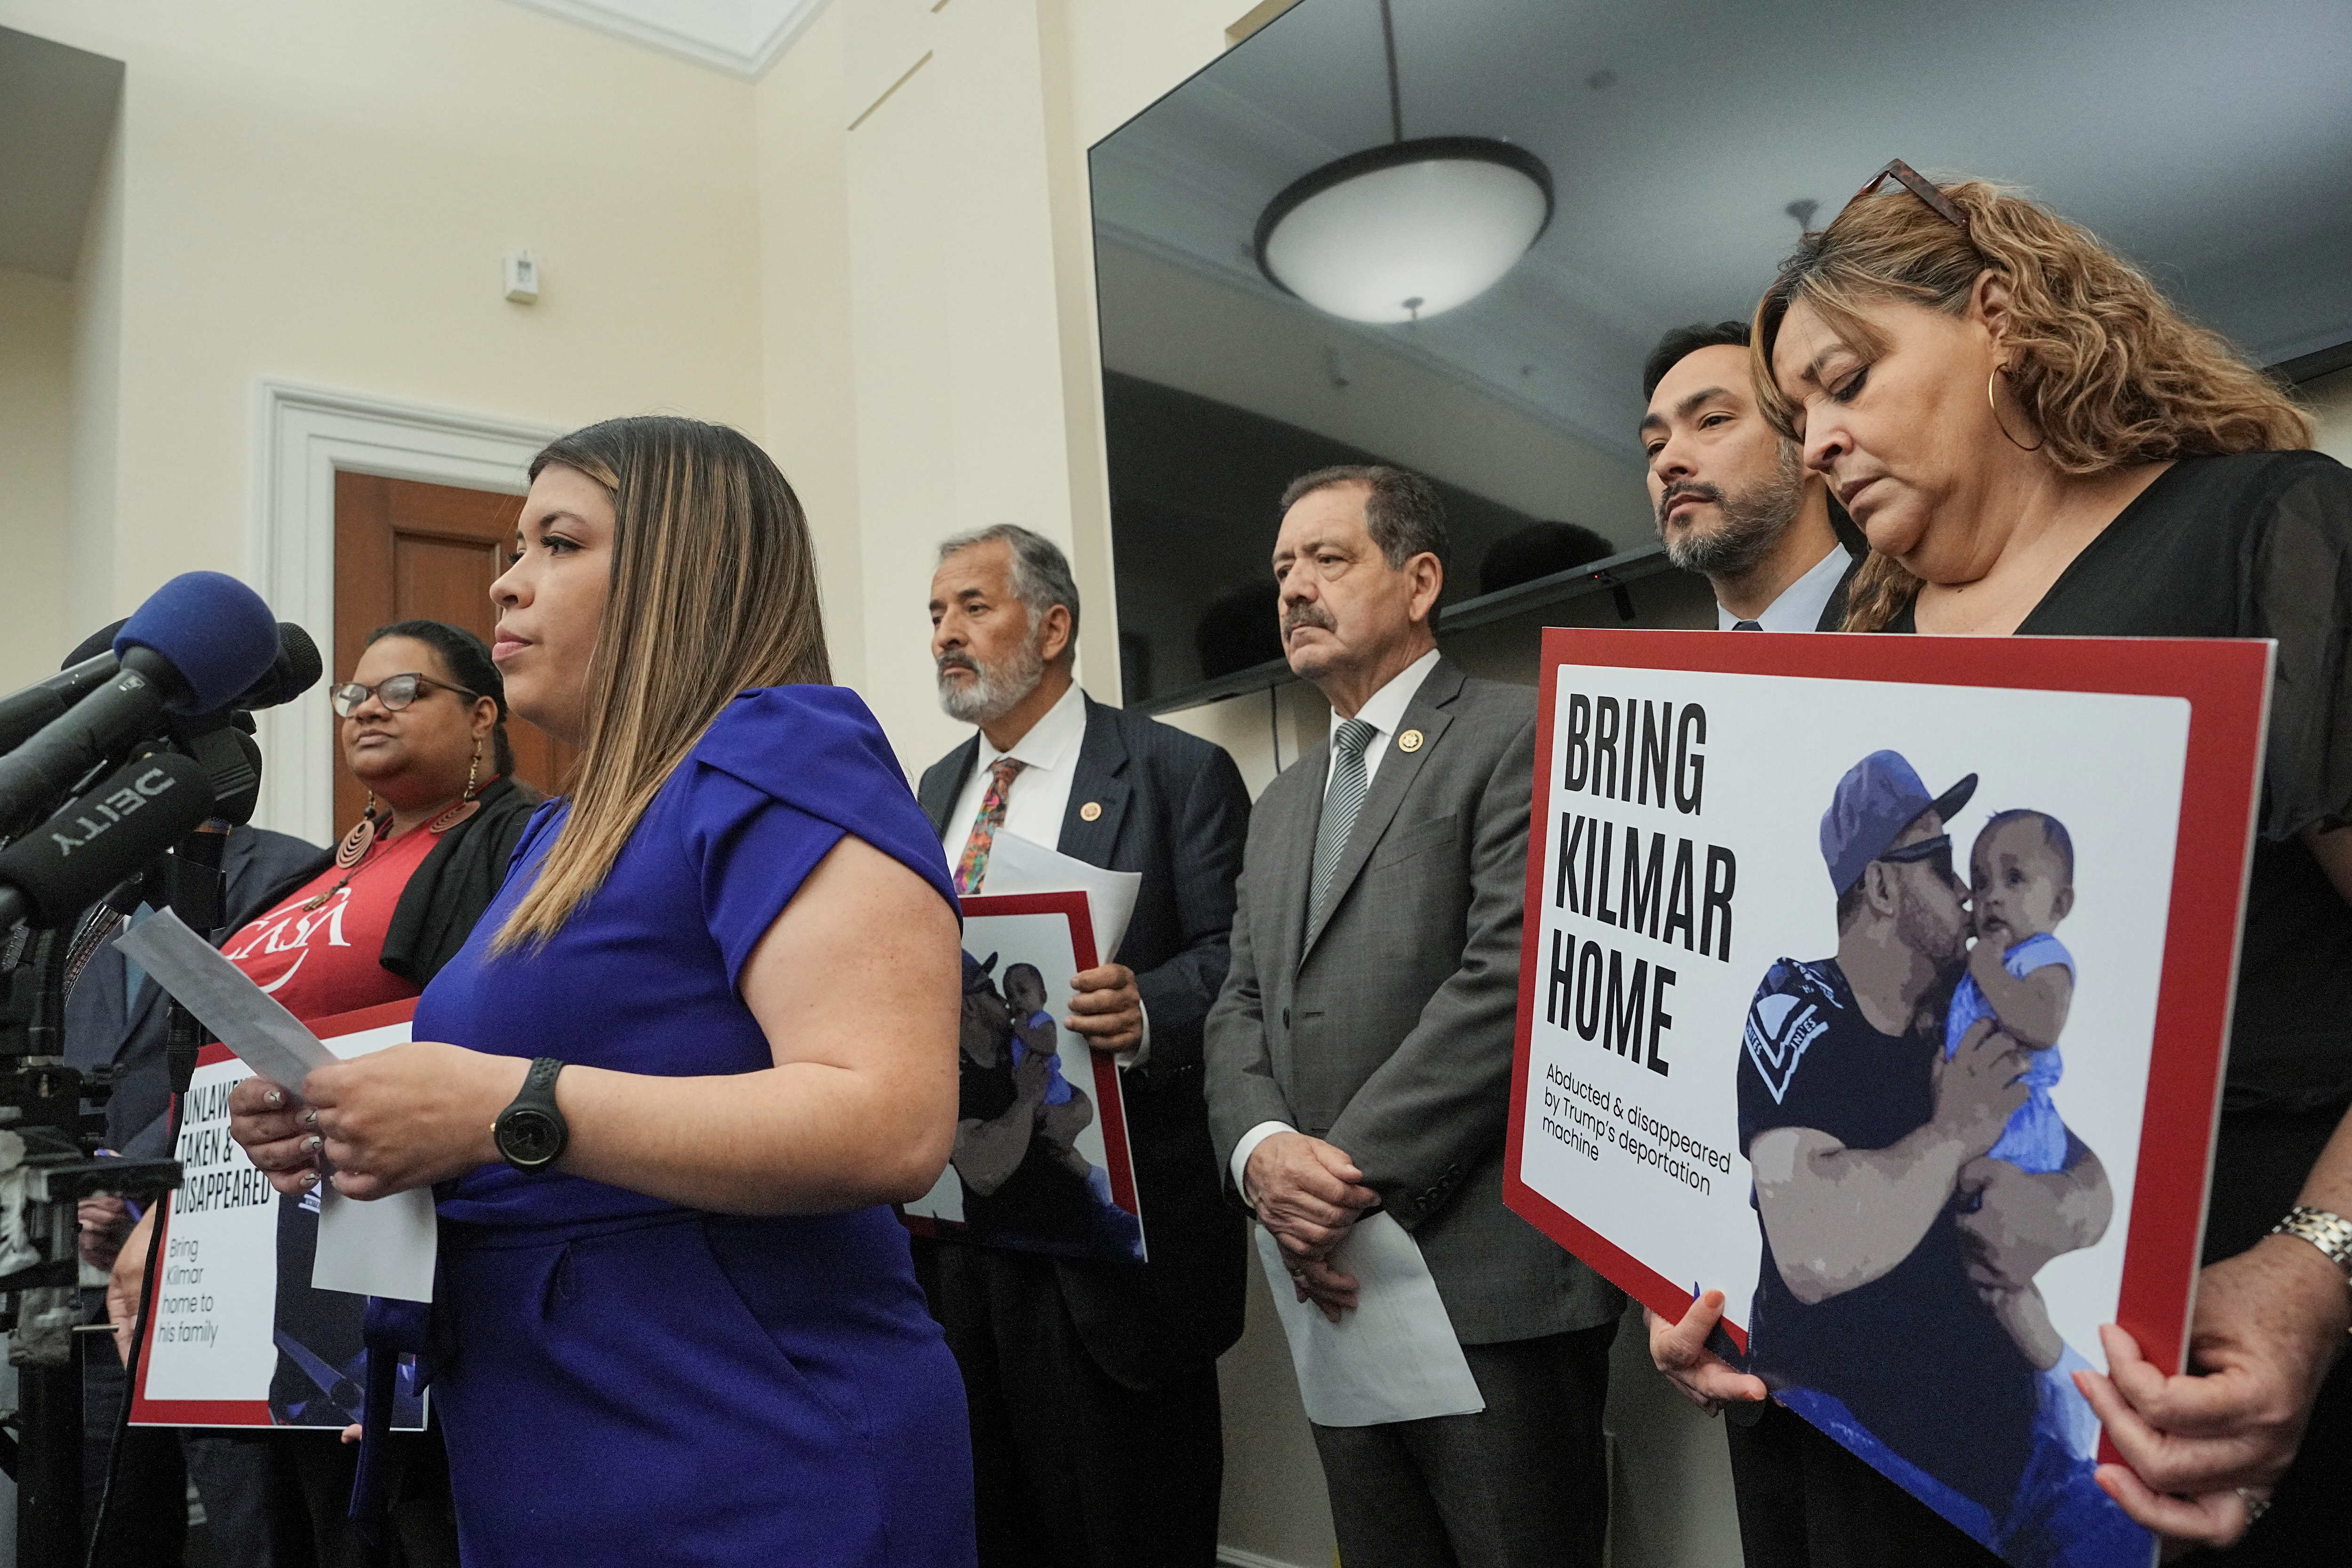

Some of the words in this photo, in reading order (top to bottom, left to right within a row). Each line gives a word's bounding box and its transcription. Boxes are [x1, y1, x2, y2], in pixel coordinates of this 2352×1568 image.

[1565, 693, 1706, 815] BRING
[51, 768, 175, 856] DEITY
[1556, 812, 1736, 963] KILMAR
[1547, 929, 1677, 1077] HOME
[184, 1079, 242, 1125] UNLAW
[1547, 1063, 1610, 1111] Abducted
[1613, 1098, 1624, 1120] &
[1628, 1106, 1731, 1174] disappeared
[182, 1128, 220, 1169] TAKEN
[223, 1125, 233, 1163] &
[1543, 1116, 1599, 1161] machine
[1545, 1086, 1560, 1116] by
[1619, 1130, 1710, 1196] deportation
[175, 1168, 270, 1214] DISAPPEARED
[170, 1236, 198, 1262] Bring
[167, 1265, 204, 1285] Kilmar
[162, 1295, 197, 1313] home
[201, 1294, 213, 1312] to
[158, 1321, 175, 1342] his
[178, 1320, 218, 1348] family
